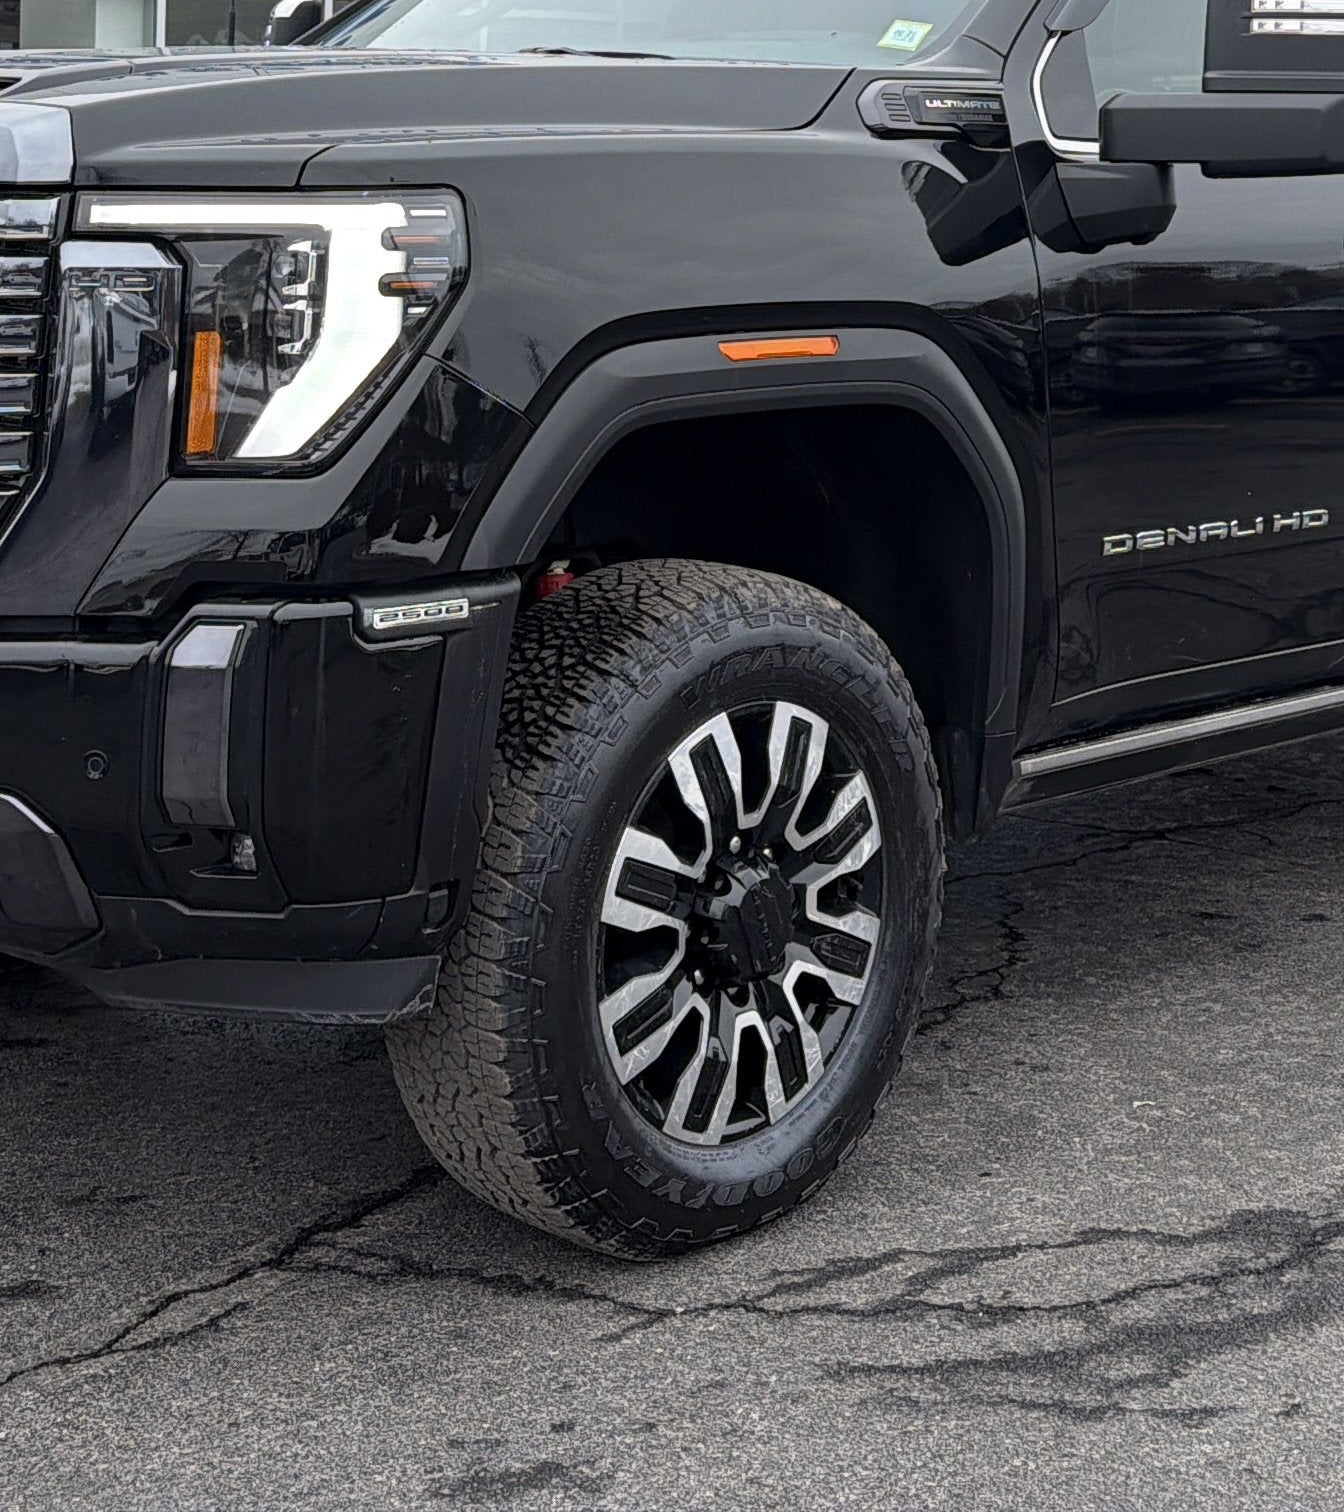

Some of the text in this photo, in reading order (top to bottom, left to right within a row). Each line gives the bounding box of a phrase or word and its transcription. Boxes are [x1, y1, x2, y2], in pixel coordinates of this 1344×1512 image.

[925, 98, 1001, 110] ULTIMATE
[1102, 508, 1329, 556] DENALI HD
[377, 602, 465, 626] 2500
[679, 642, 916, 774] WRANGLER
[579, 1076, 849, 1210] GOODYEAR
